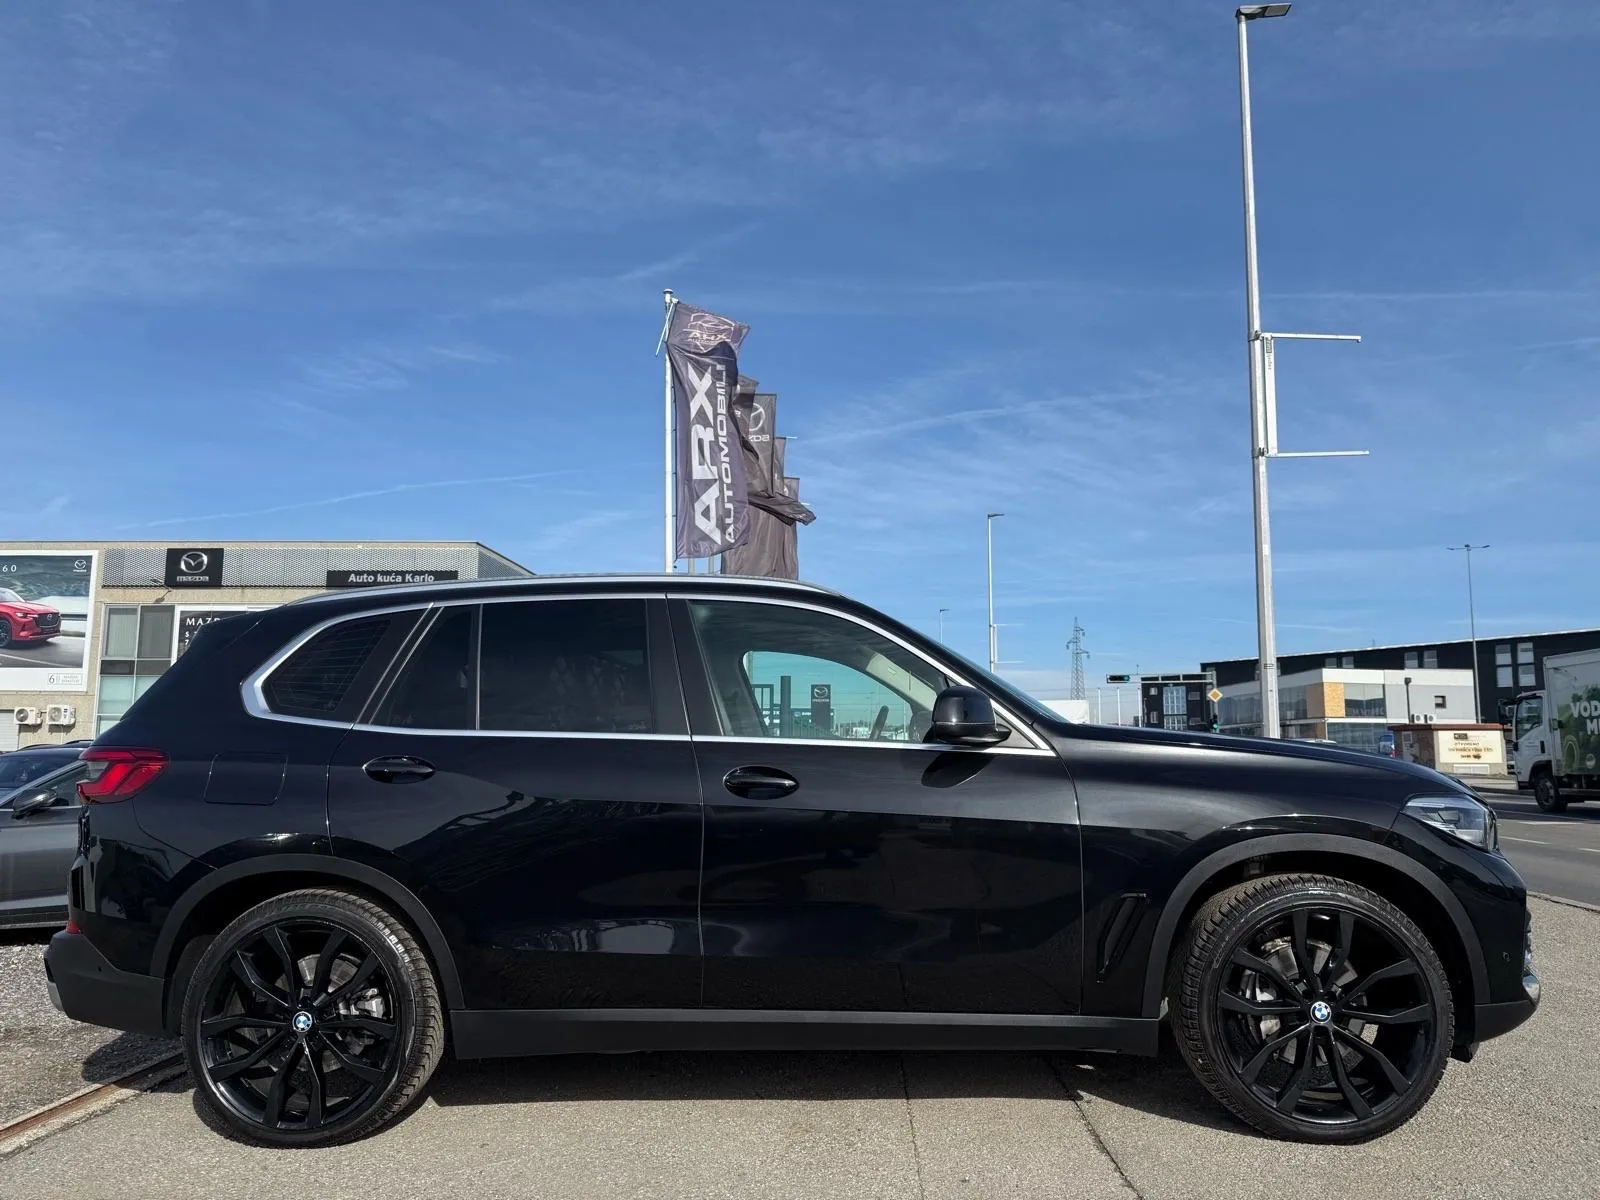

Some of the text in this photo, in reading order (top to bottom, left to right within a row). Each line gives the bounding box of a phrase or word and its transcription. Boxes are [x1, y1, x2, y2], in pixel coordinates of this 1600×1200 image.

[687, 362, 722, 545] ARX
[715, 364, 736, 543] AUTOMOBILI
[186, 617, 221, 626] MAZ
[348, 572, 435, 583] Auto kuća Karlo
